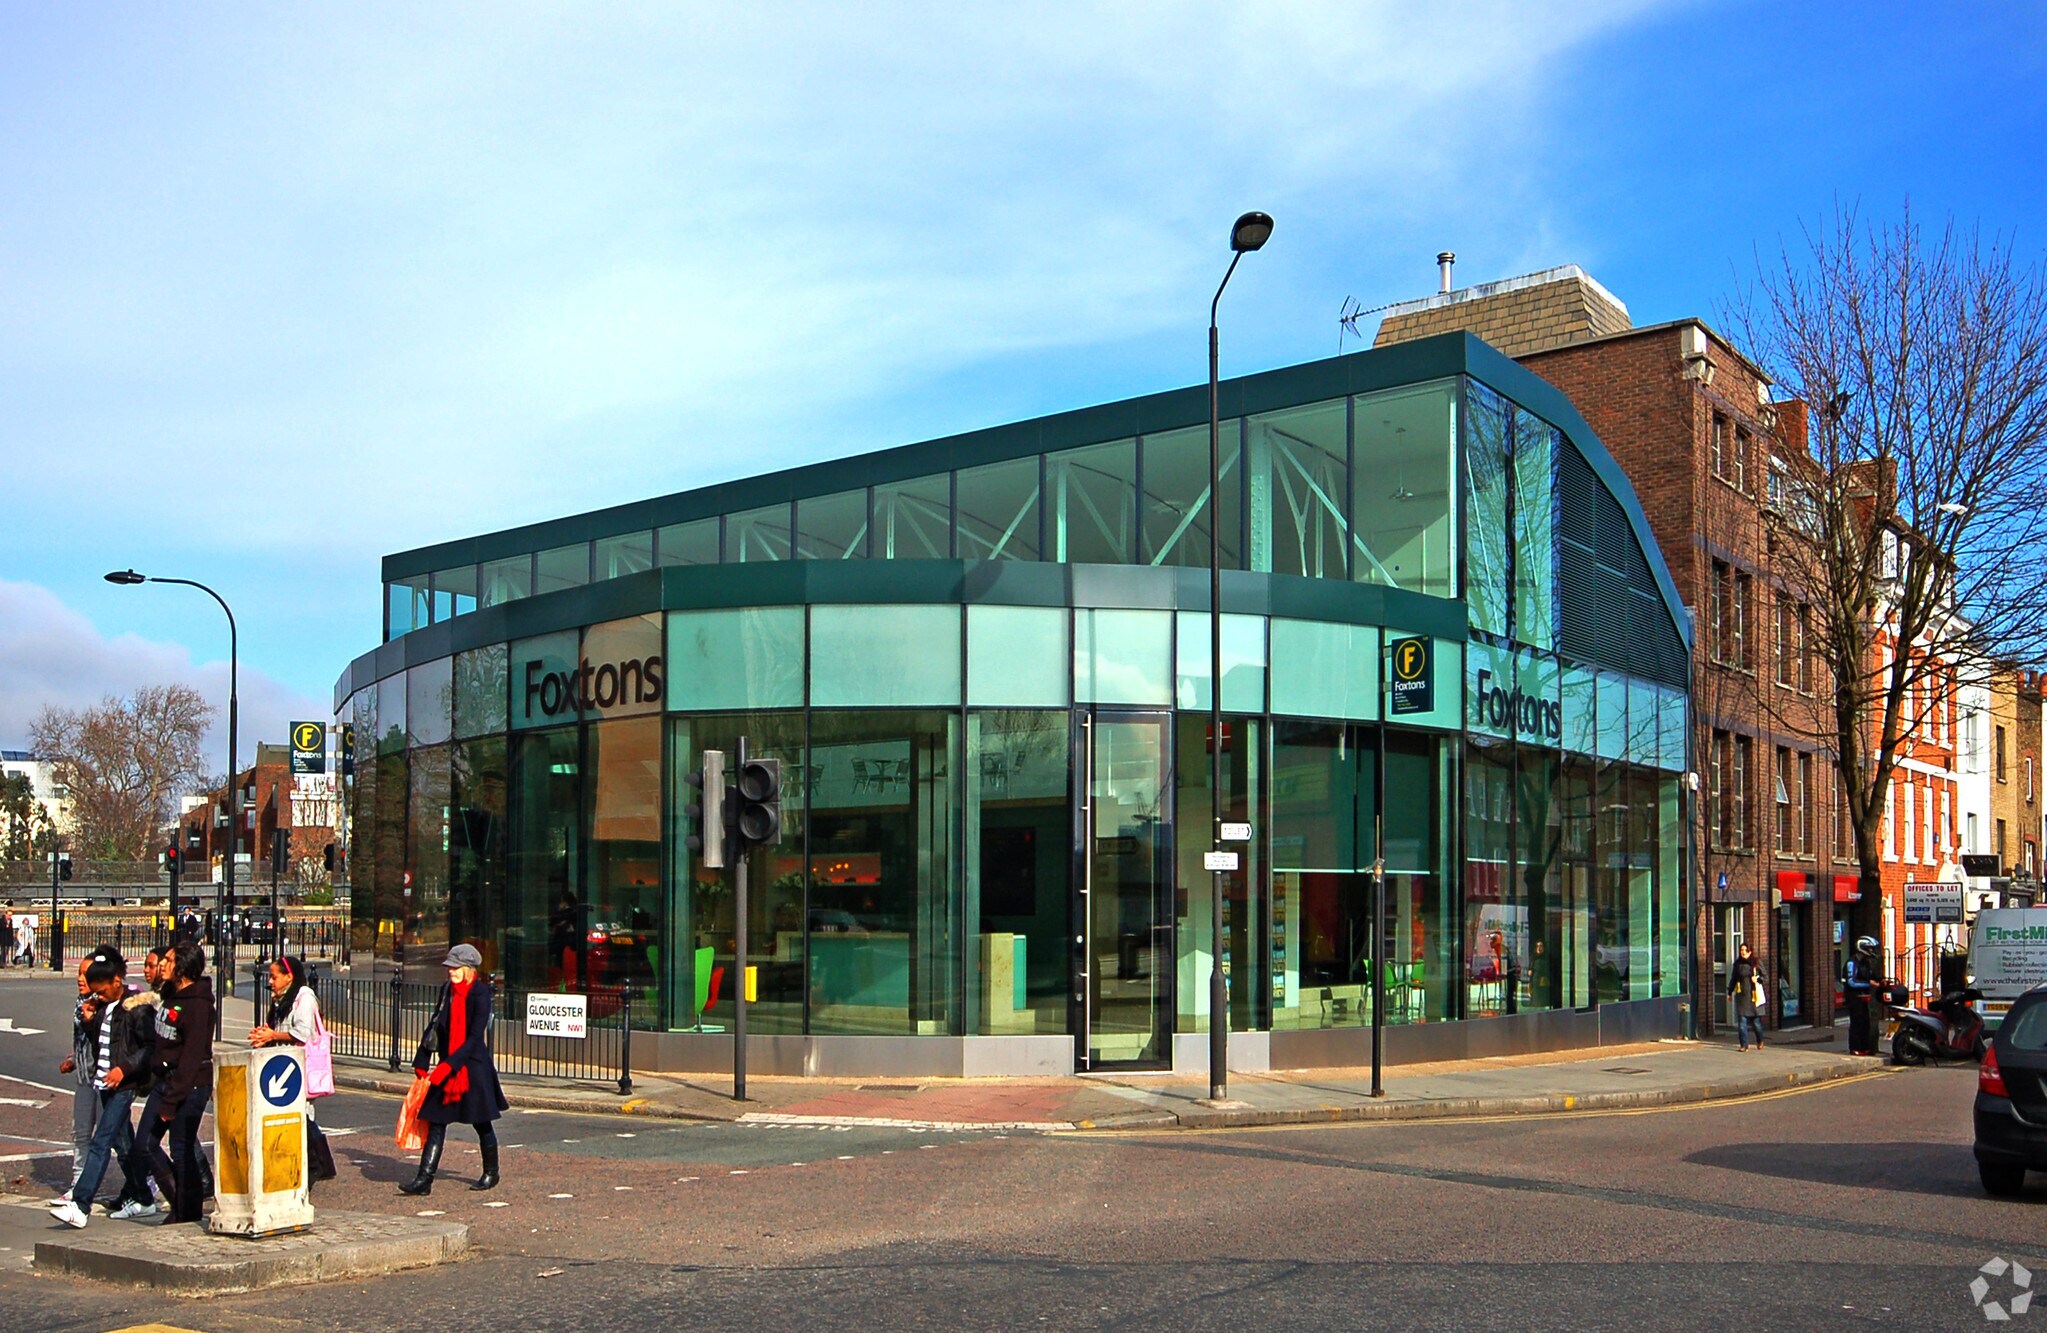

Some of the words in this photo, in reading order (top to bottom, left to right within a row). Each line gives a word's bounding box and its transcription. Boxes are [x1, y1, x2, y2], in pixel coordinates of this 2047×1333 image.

[1404, 646, 1416, 673] F
[525, 656, 662, 718] Foxtons
[1394, 680, 1426, 692] Foxtons
[1478, 668, 1560, 739] Foxtons
[302, 727, 314, 747] F
[293, 750, 322, 759] Foxtons
[529, 1004, 584, 1018] GLOUCESTER
[529, 1019, 560, 1032] AVENUE
[567, 1024, 583, 1032] NW1
